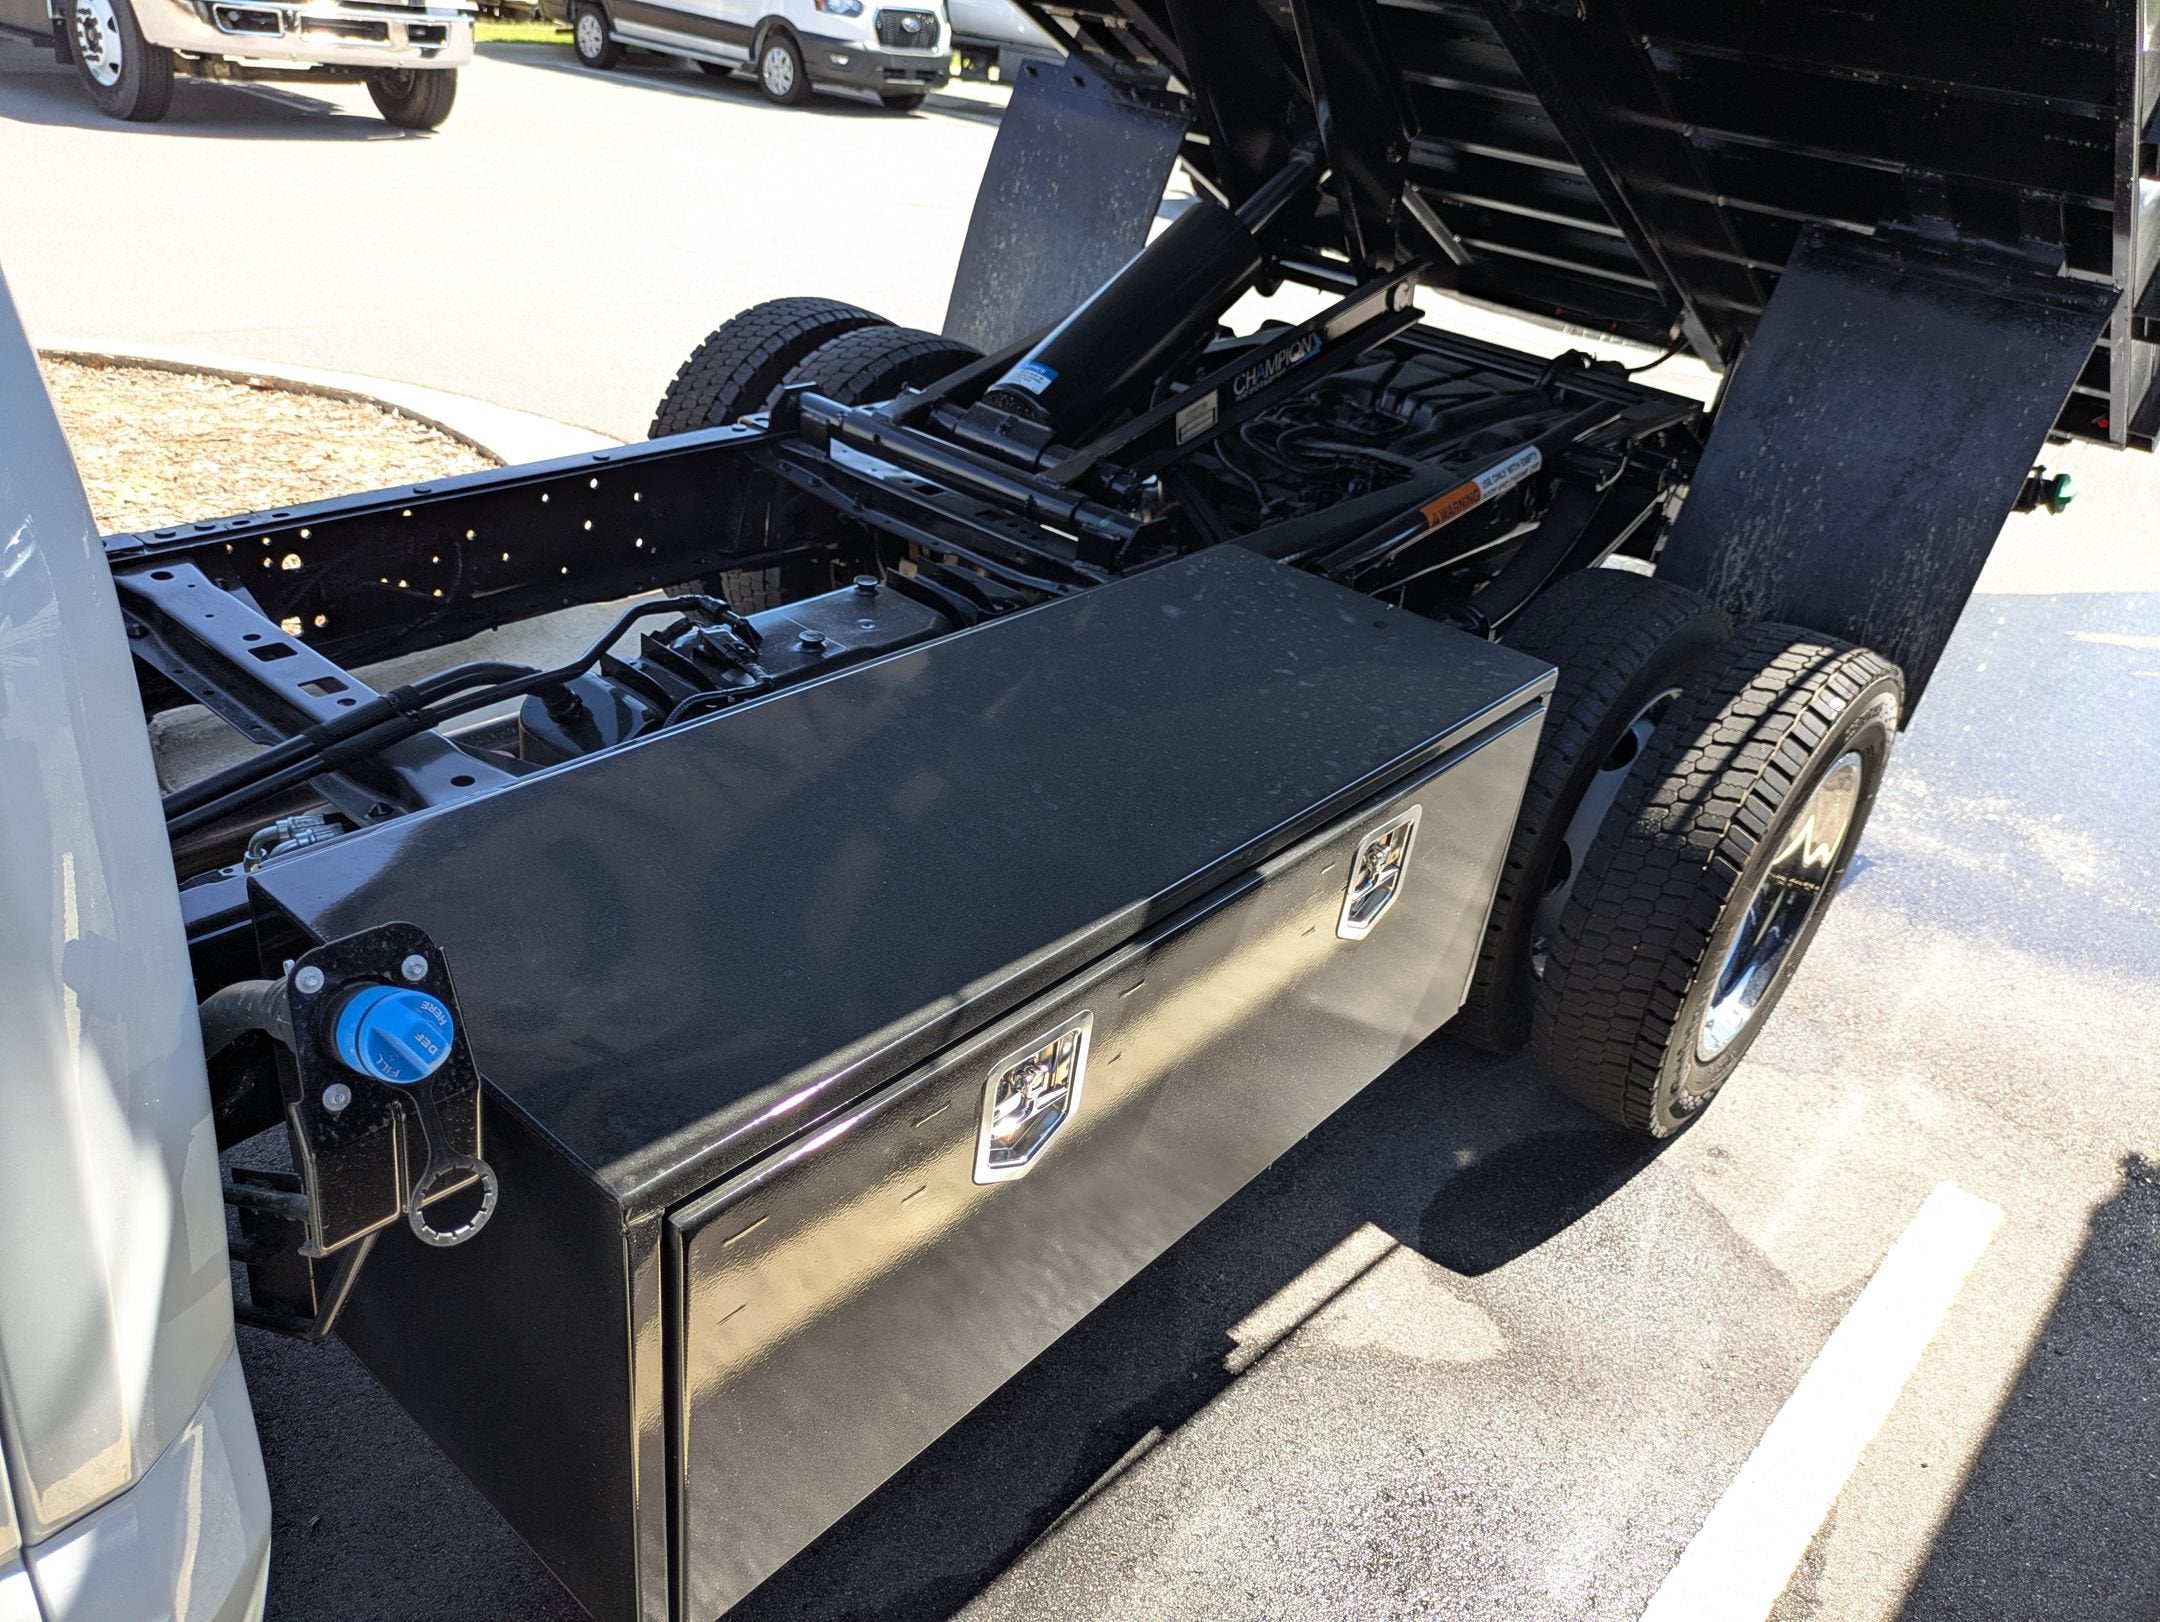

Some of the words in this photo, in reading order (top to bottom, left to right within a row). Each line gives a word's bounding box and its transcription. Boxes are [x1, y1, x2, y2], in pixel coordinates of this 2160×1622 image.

[1233, 335, 1313, 395] CHAMPION
[1440, 489, 1480, 520] WARNING
[420, 1000, 447, 1026] HERE
[414, 1033, 438, 1056] DEF
[375, 1053, 401, 1078] FILL
